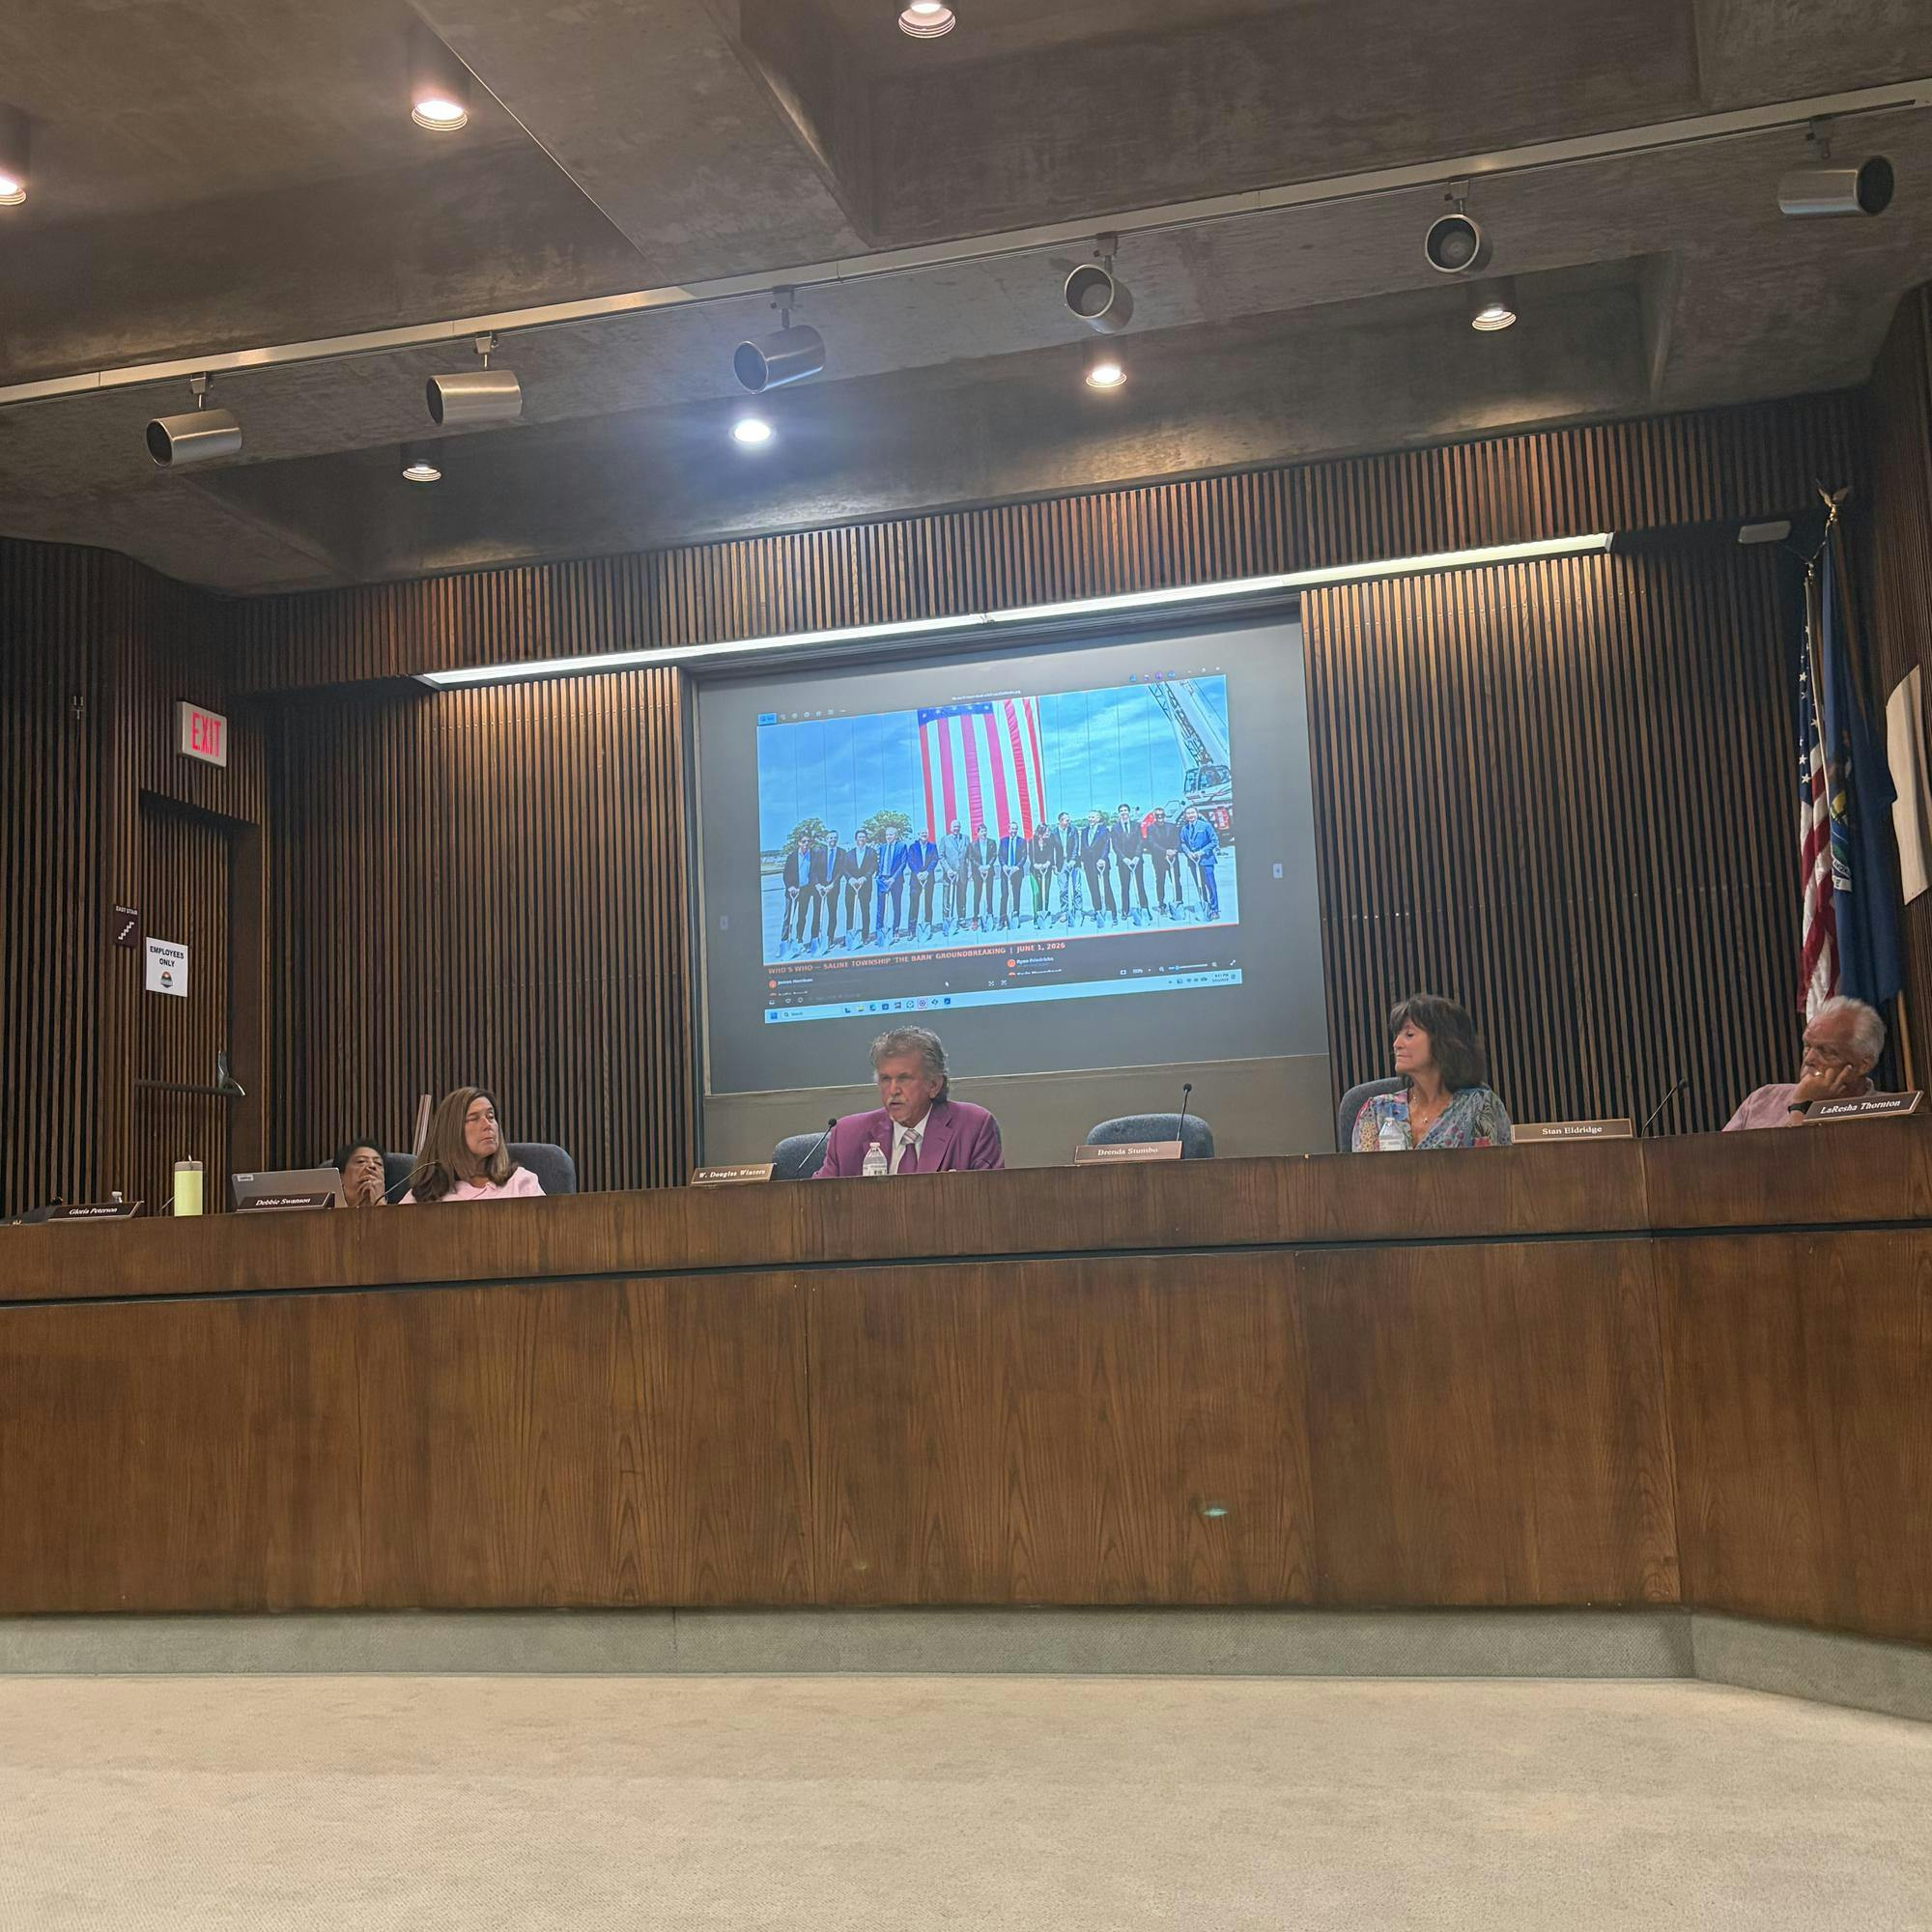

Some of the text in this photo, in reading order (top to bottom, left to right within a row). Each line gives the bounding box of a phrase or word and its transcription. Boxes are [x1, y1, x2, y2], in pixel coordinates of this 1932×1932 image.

[191, 711, 221, 758] EXIT
[150, 946, 185, 959] EMPLOYEES
[823, 961, 848, 970] SALINE
[851, 957, 891, 967] TOWNSHIP
[935, 947, 1006, 959] GROUNDBREAKING
[1016, 945, 1036, 953] JUNE
[1046, 942, 1065, 951] 2026
[159, 958, 175, 967] ONLY
[1820, 1100, 1900, 1115] LaResha Thornton
[1564, 1125, 1603, 1134] Eldridge
[1097, 1146, 1158, 1156] Brenda Stumbo
